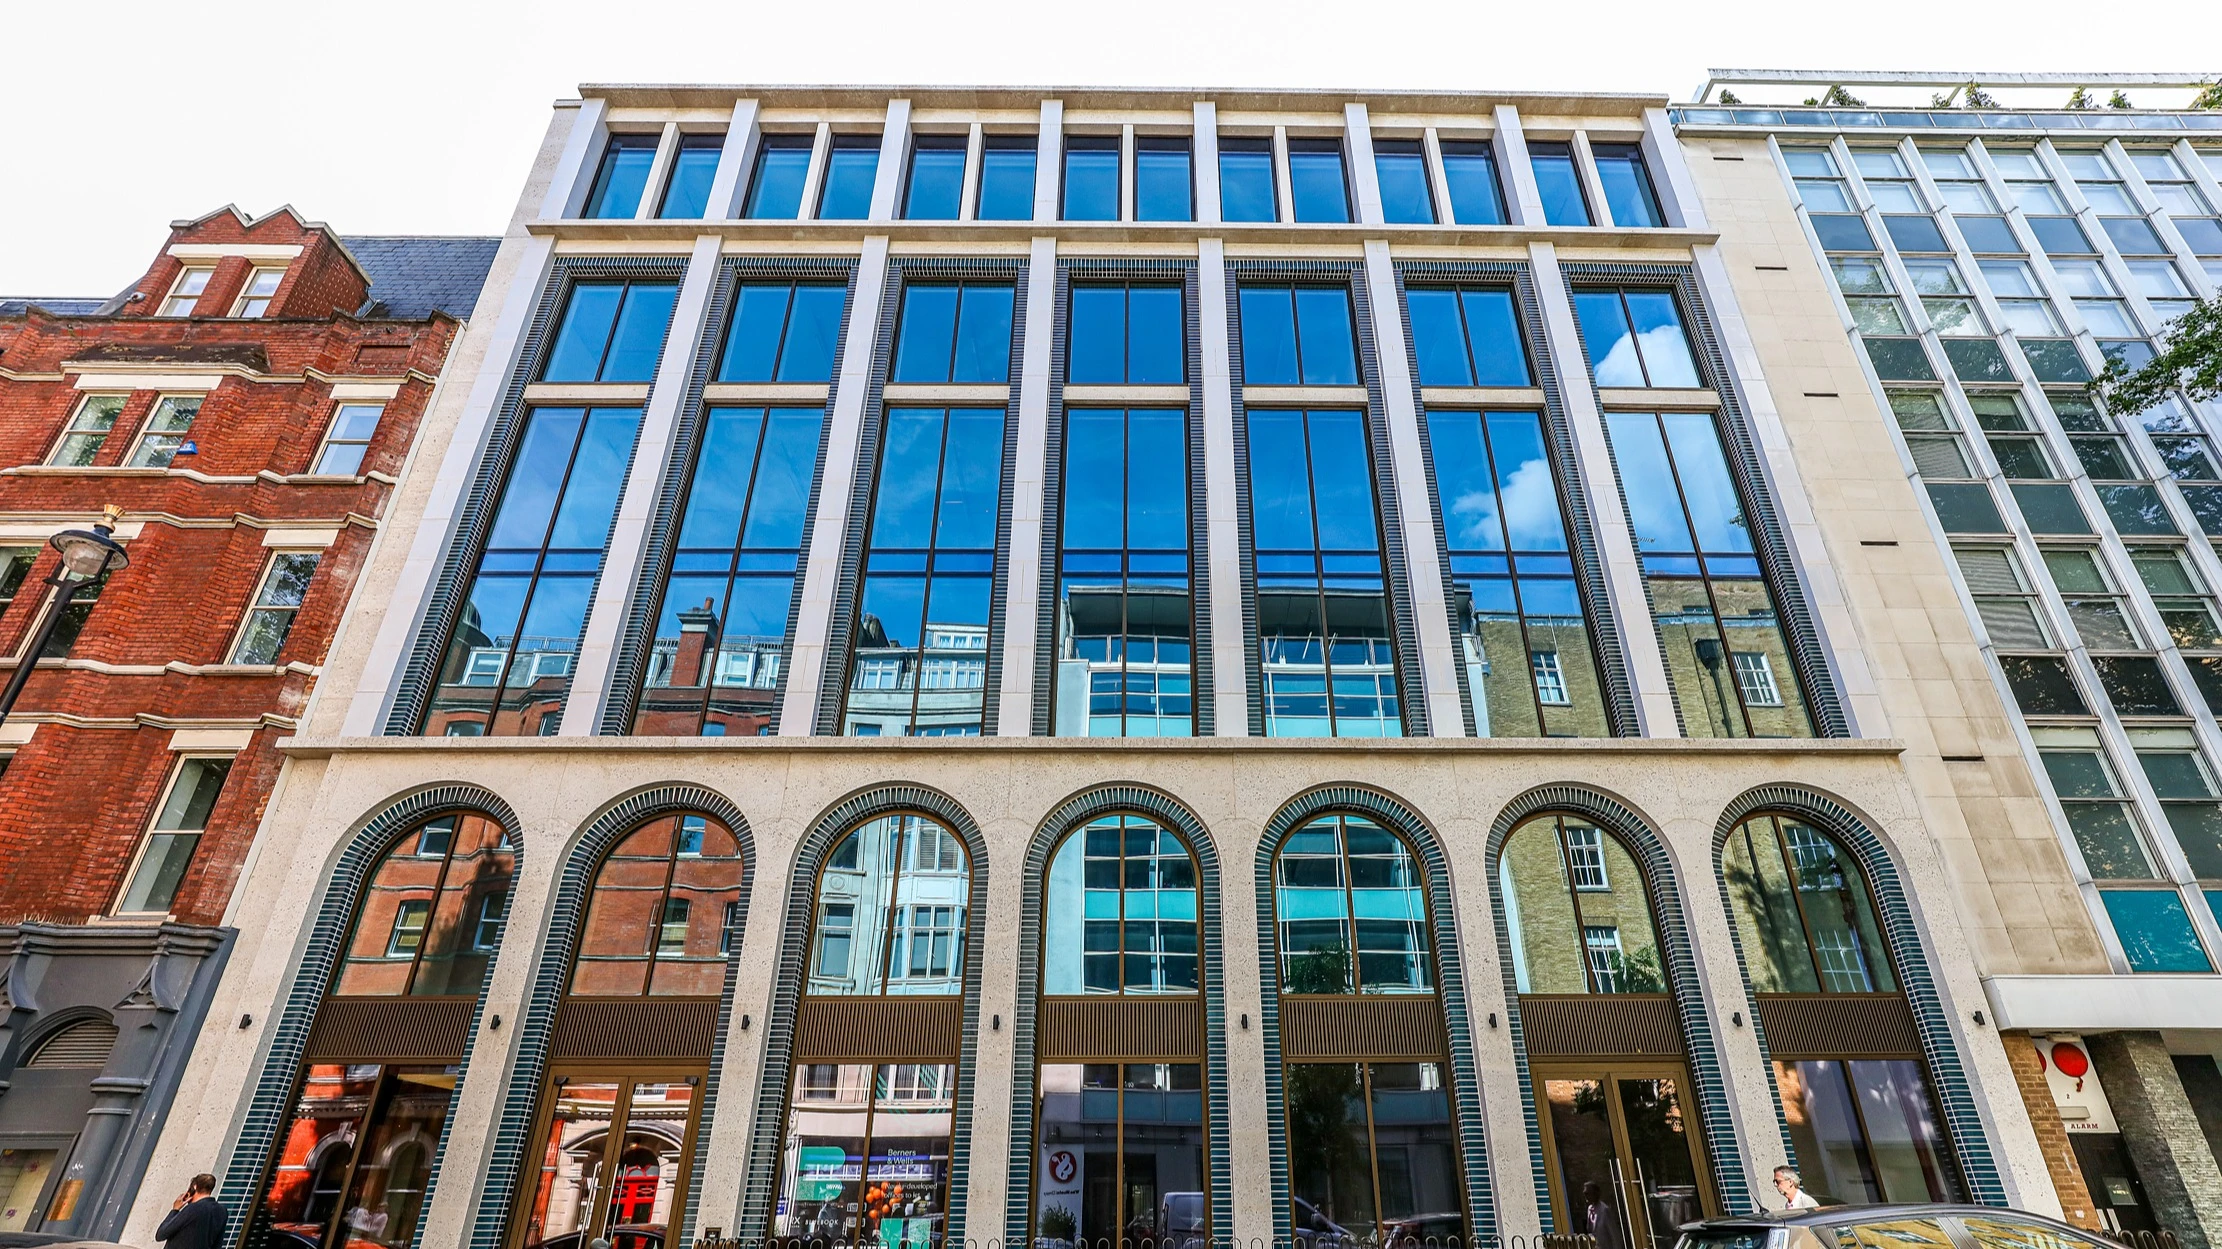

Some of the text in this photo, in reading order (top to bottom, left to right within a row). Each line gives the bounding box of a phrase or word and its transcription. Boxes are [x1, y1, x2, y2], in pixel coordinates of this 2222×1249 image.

[887, 1148, 916, 1156] Berners
[887, 1157, 914, 1165] & Wells
